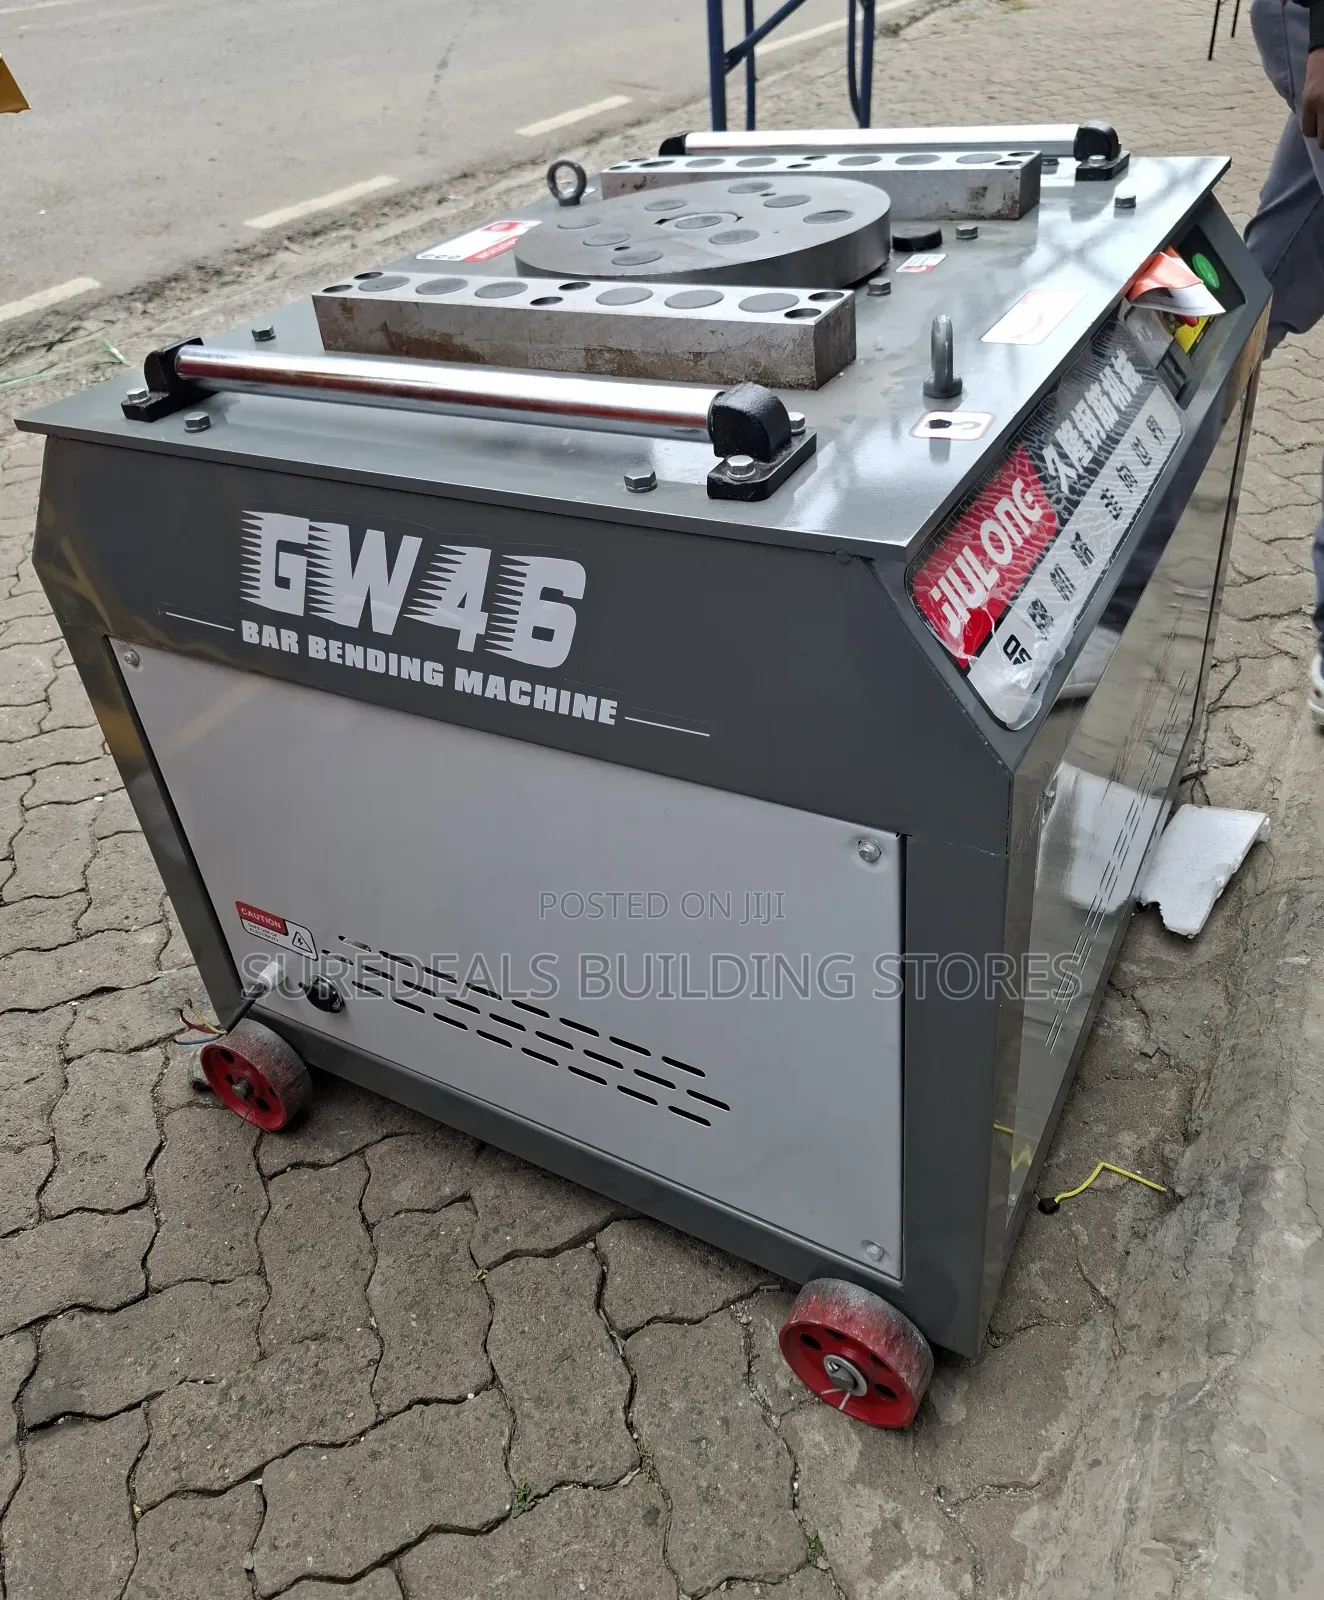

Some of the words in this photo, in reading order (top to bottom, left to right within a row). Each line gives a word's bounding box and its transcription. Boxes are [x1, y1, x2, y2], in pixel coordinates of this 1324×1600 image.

[239, 509, 586, 668] GW46
[241, 619, 299, 654] BAR
[308, 634, 444, 687] BENDING
[454, 670, 618, 726] MACHINE
[240, 907, 282, 929] CAUTION
